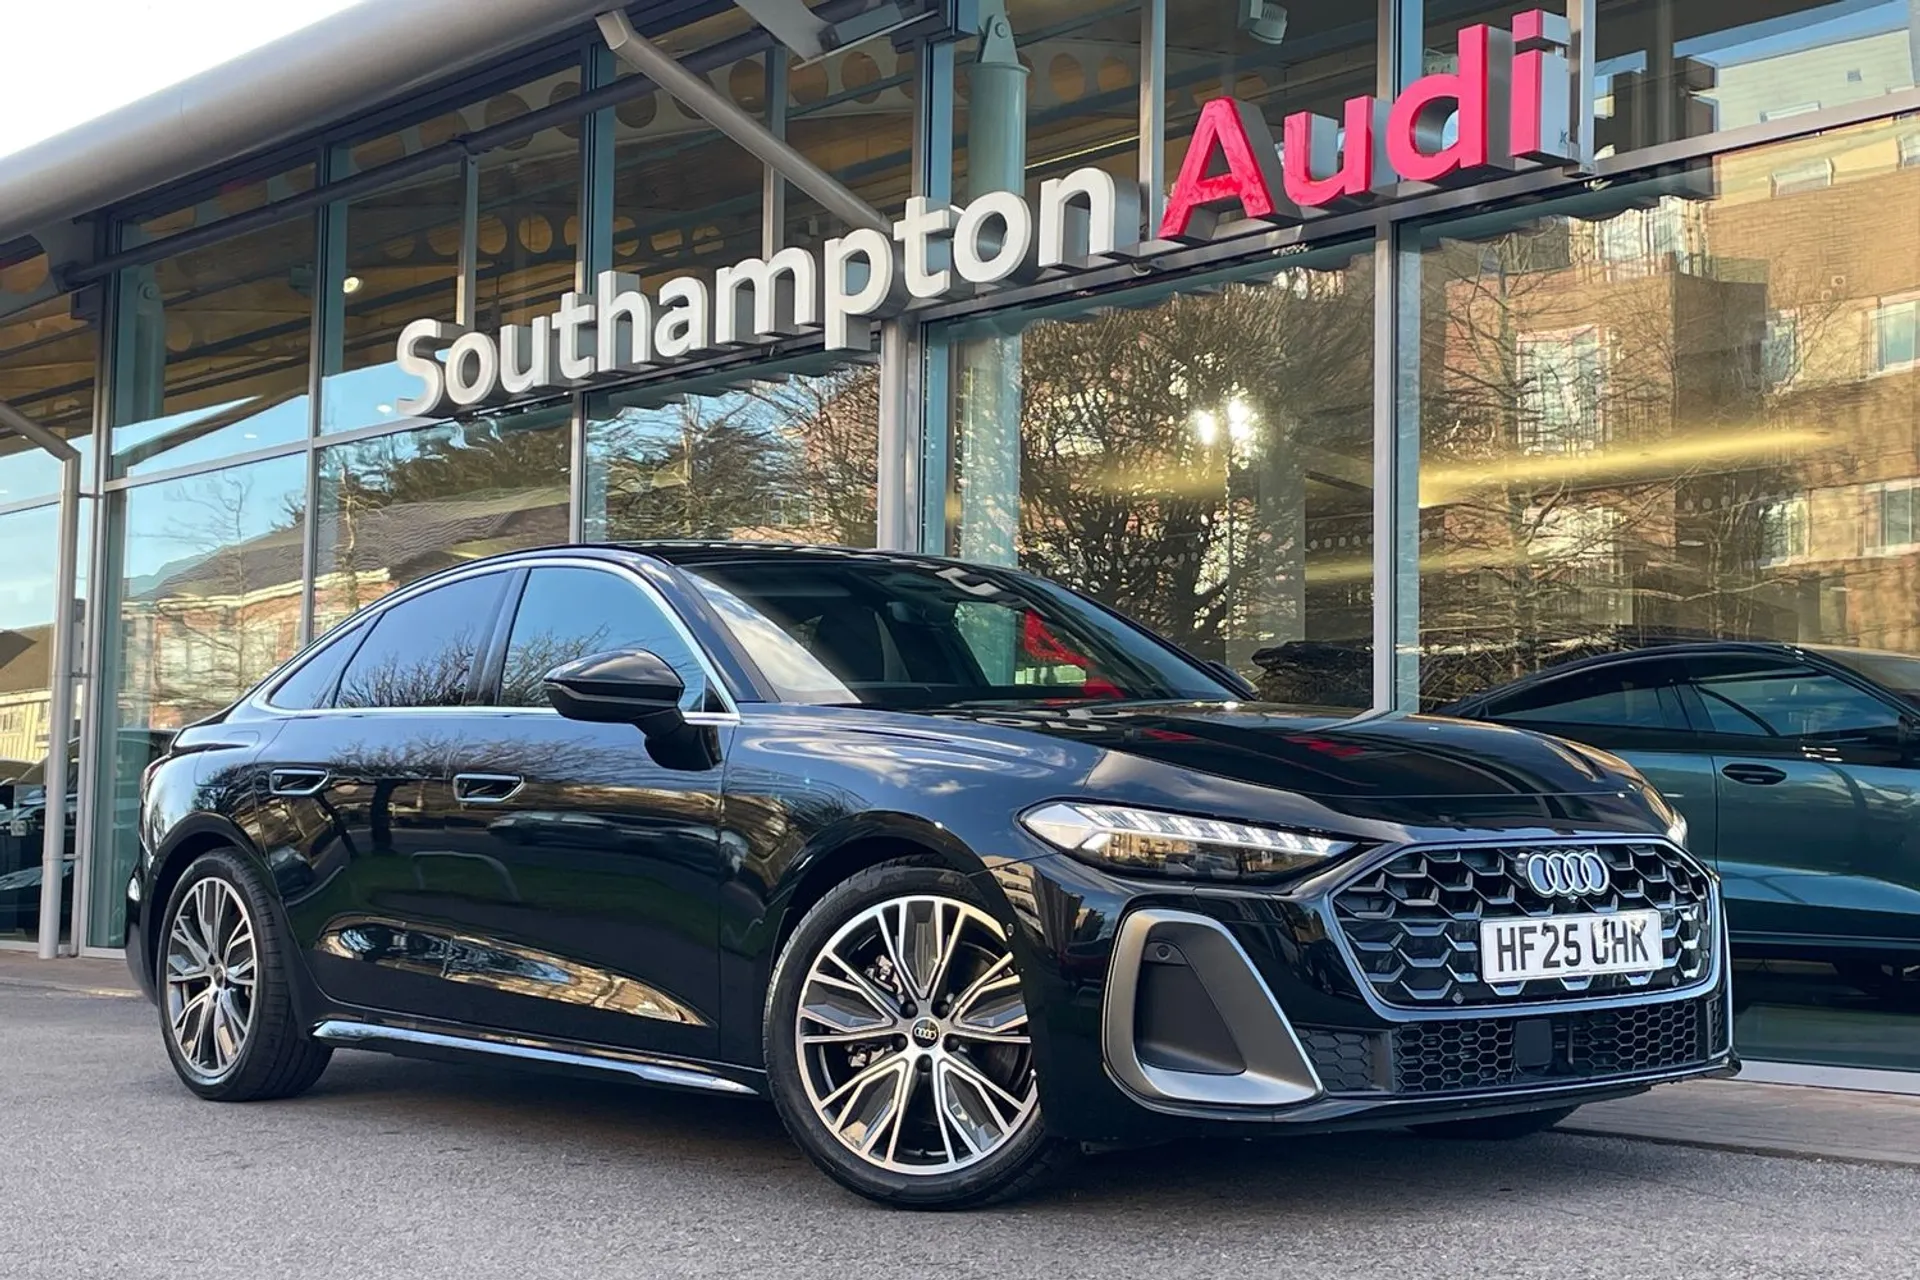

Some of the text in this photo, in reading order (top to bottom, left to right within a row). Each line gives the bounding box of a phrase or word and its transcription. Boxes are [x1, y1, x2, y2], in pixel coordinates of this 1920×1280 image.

[397, 9, 1548, 416] Southampton Audi
[1496, 919, 1649, 972] HF25 UHK
